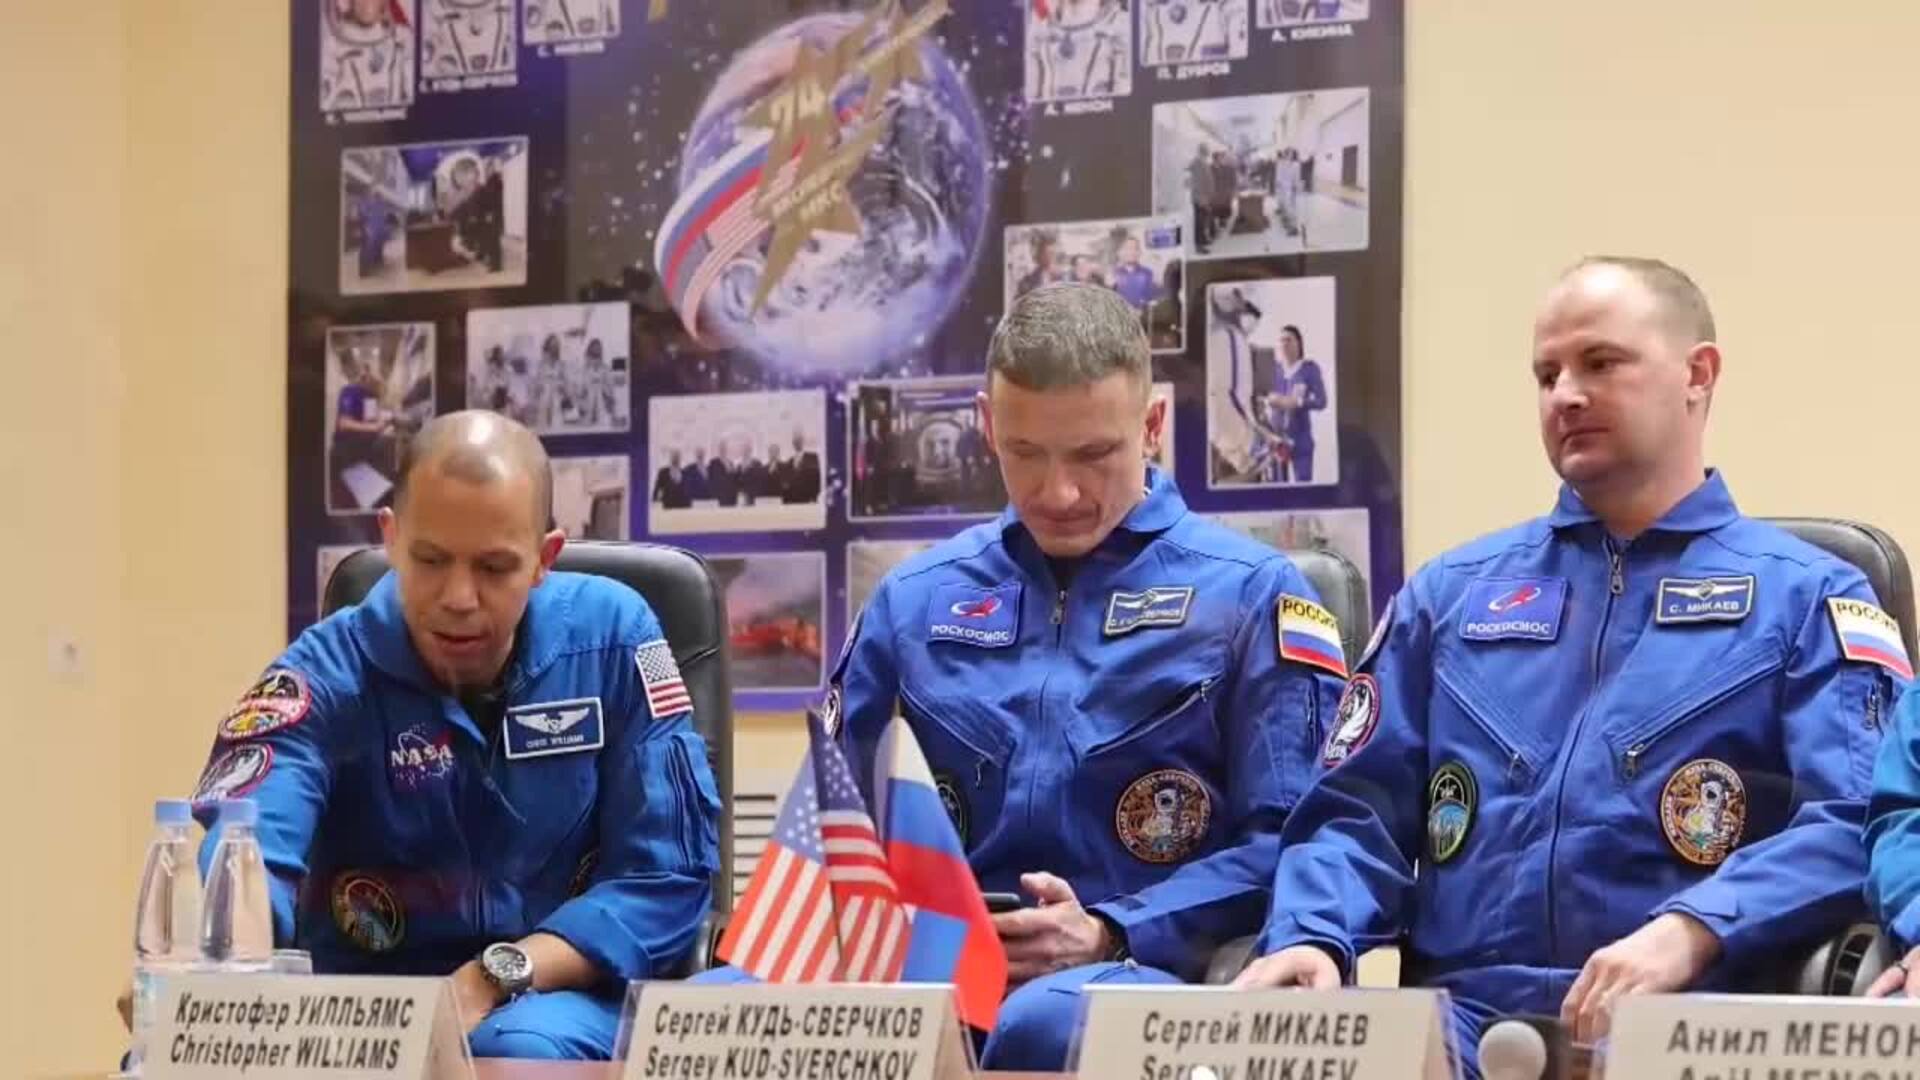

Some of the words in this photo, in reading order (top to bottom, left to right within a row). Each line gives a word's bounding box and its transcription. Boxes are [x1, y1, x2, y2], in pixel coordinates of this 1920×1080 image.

[931, 624, 1009, 642] РОСКОСМОС
[391, 744, 454, 767] NASA
[174, 992, 290, 1029] Кристофер
[294, 995, 414, 1029] УИЛЛЬЯМС
[654, 1004, 731, 1043] Сергей
[735, 1005, 923, 1042] КУДЬ-СВЕРЧКОВ
[1142, 1010, 1242, 1052] Сергей
[1250, 1012, 1369, 1047] МИКАЕВ
[1666, 1019, 1769, 1054] Анил
[170, 1033, 291, 1074] Christopher
[298, 1035, 402, 1069] WILLIAMS
[724, 1047, 917, 1080] KUD-SVERCHKOV
